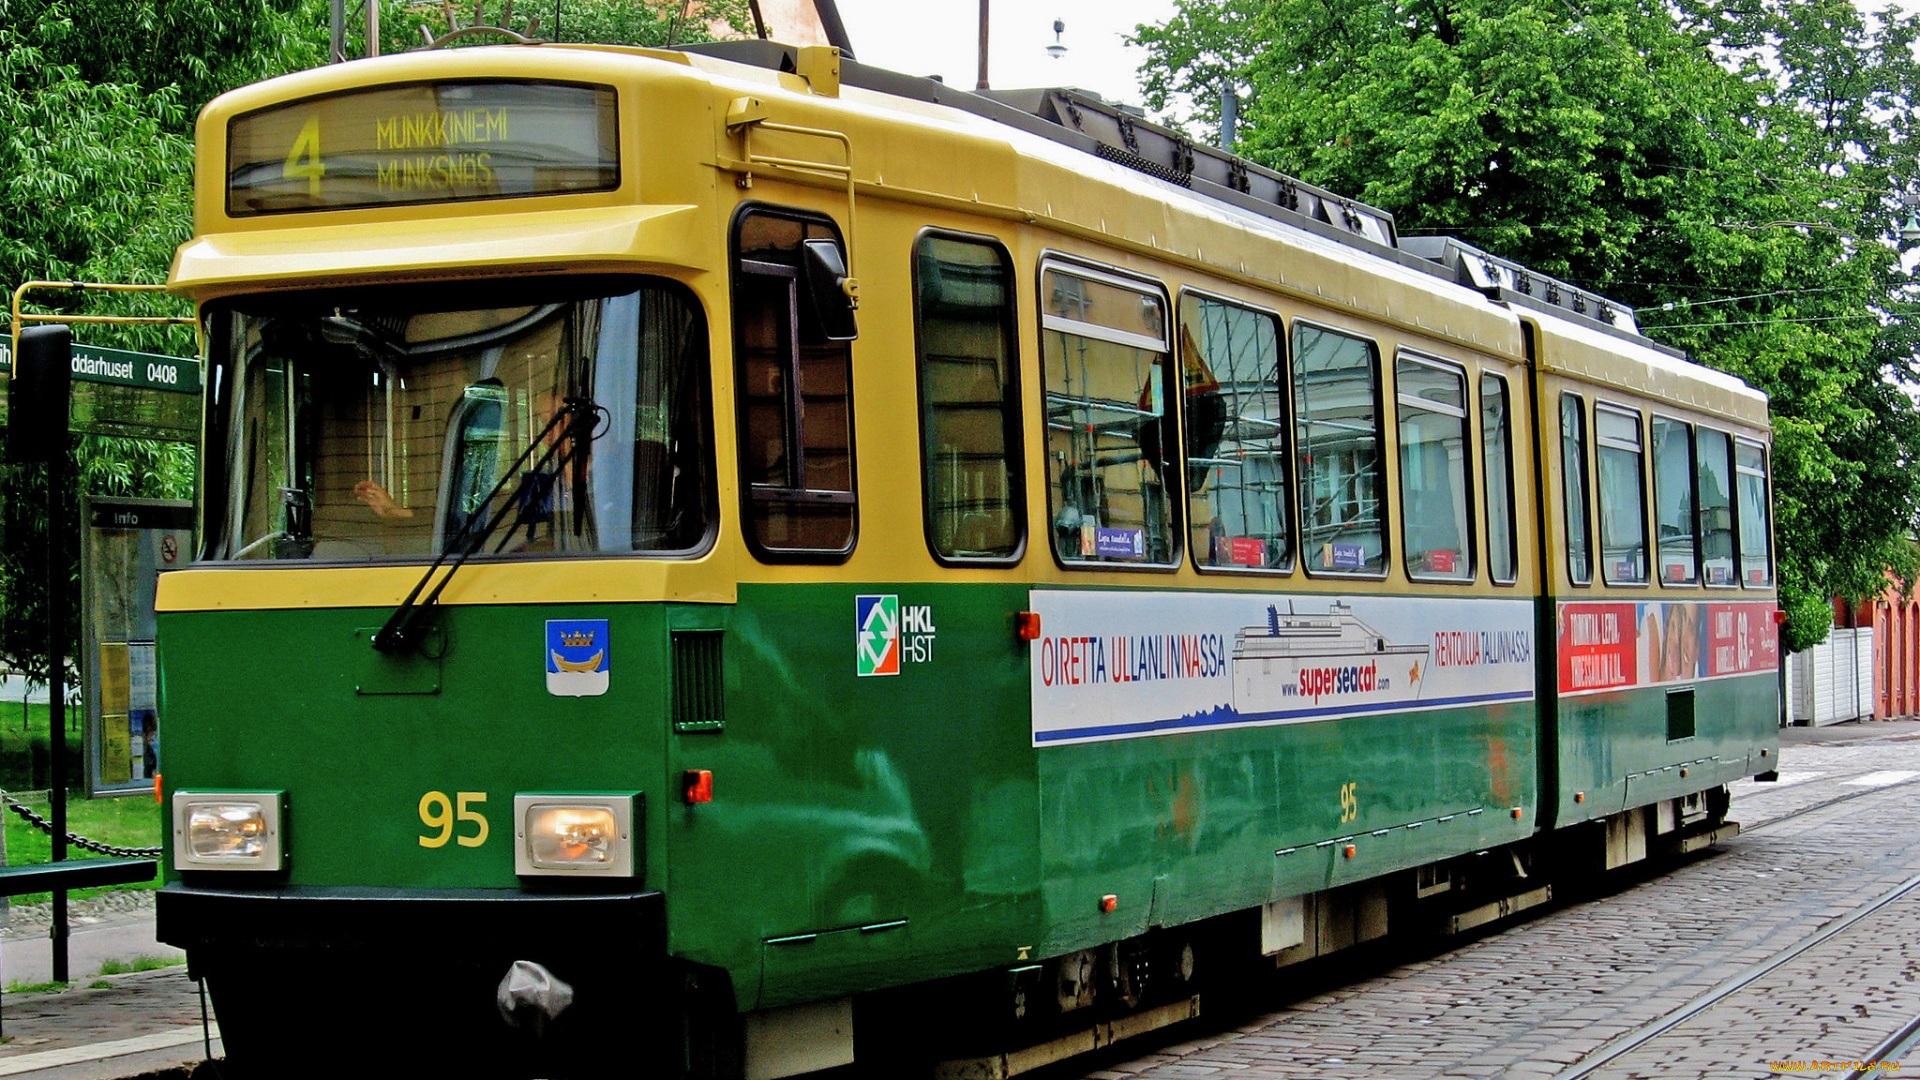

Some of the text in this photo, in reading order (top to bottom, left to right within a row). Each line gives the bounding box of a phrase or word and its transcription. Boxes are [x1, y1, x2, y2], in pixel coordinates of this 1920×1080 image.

[377, 106, 507, 150] MUNKKINIEMI
[282, 114, 325, 195] 4
[377, 153, 492, 192] MUNKSNÄS
[147, 363, 178, 384] 0408
[114, 511, 139, 526] Info
[902, 605, 935, 633] HKL
[902, 635, 935, 663] HST
[1041, 633, 1227, 687] OIRETTA ULLANLINNASSA
[1435, 630, 1531, 666] RENTOILUA TALLINNASSA
[418, 790, 489, 848] 95
[1340, 782, 1357, 823] 95
